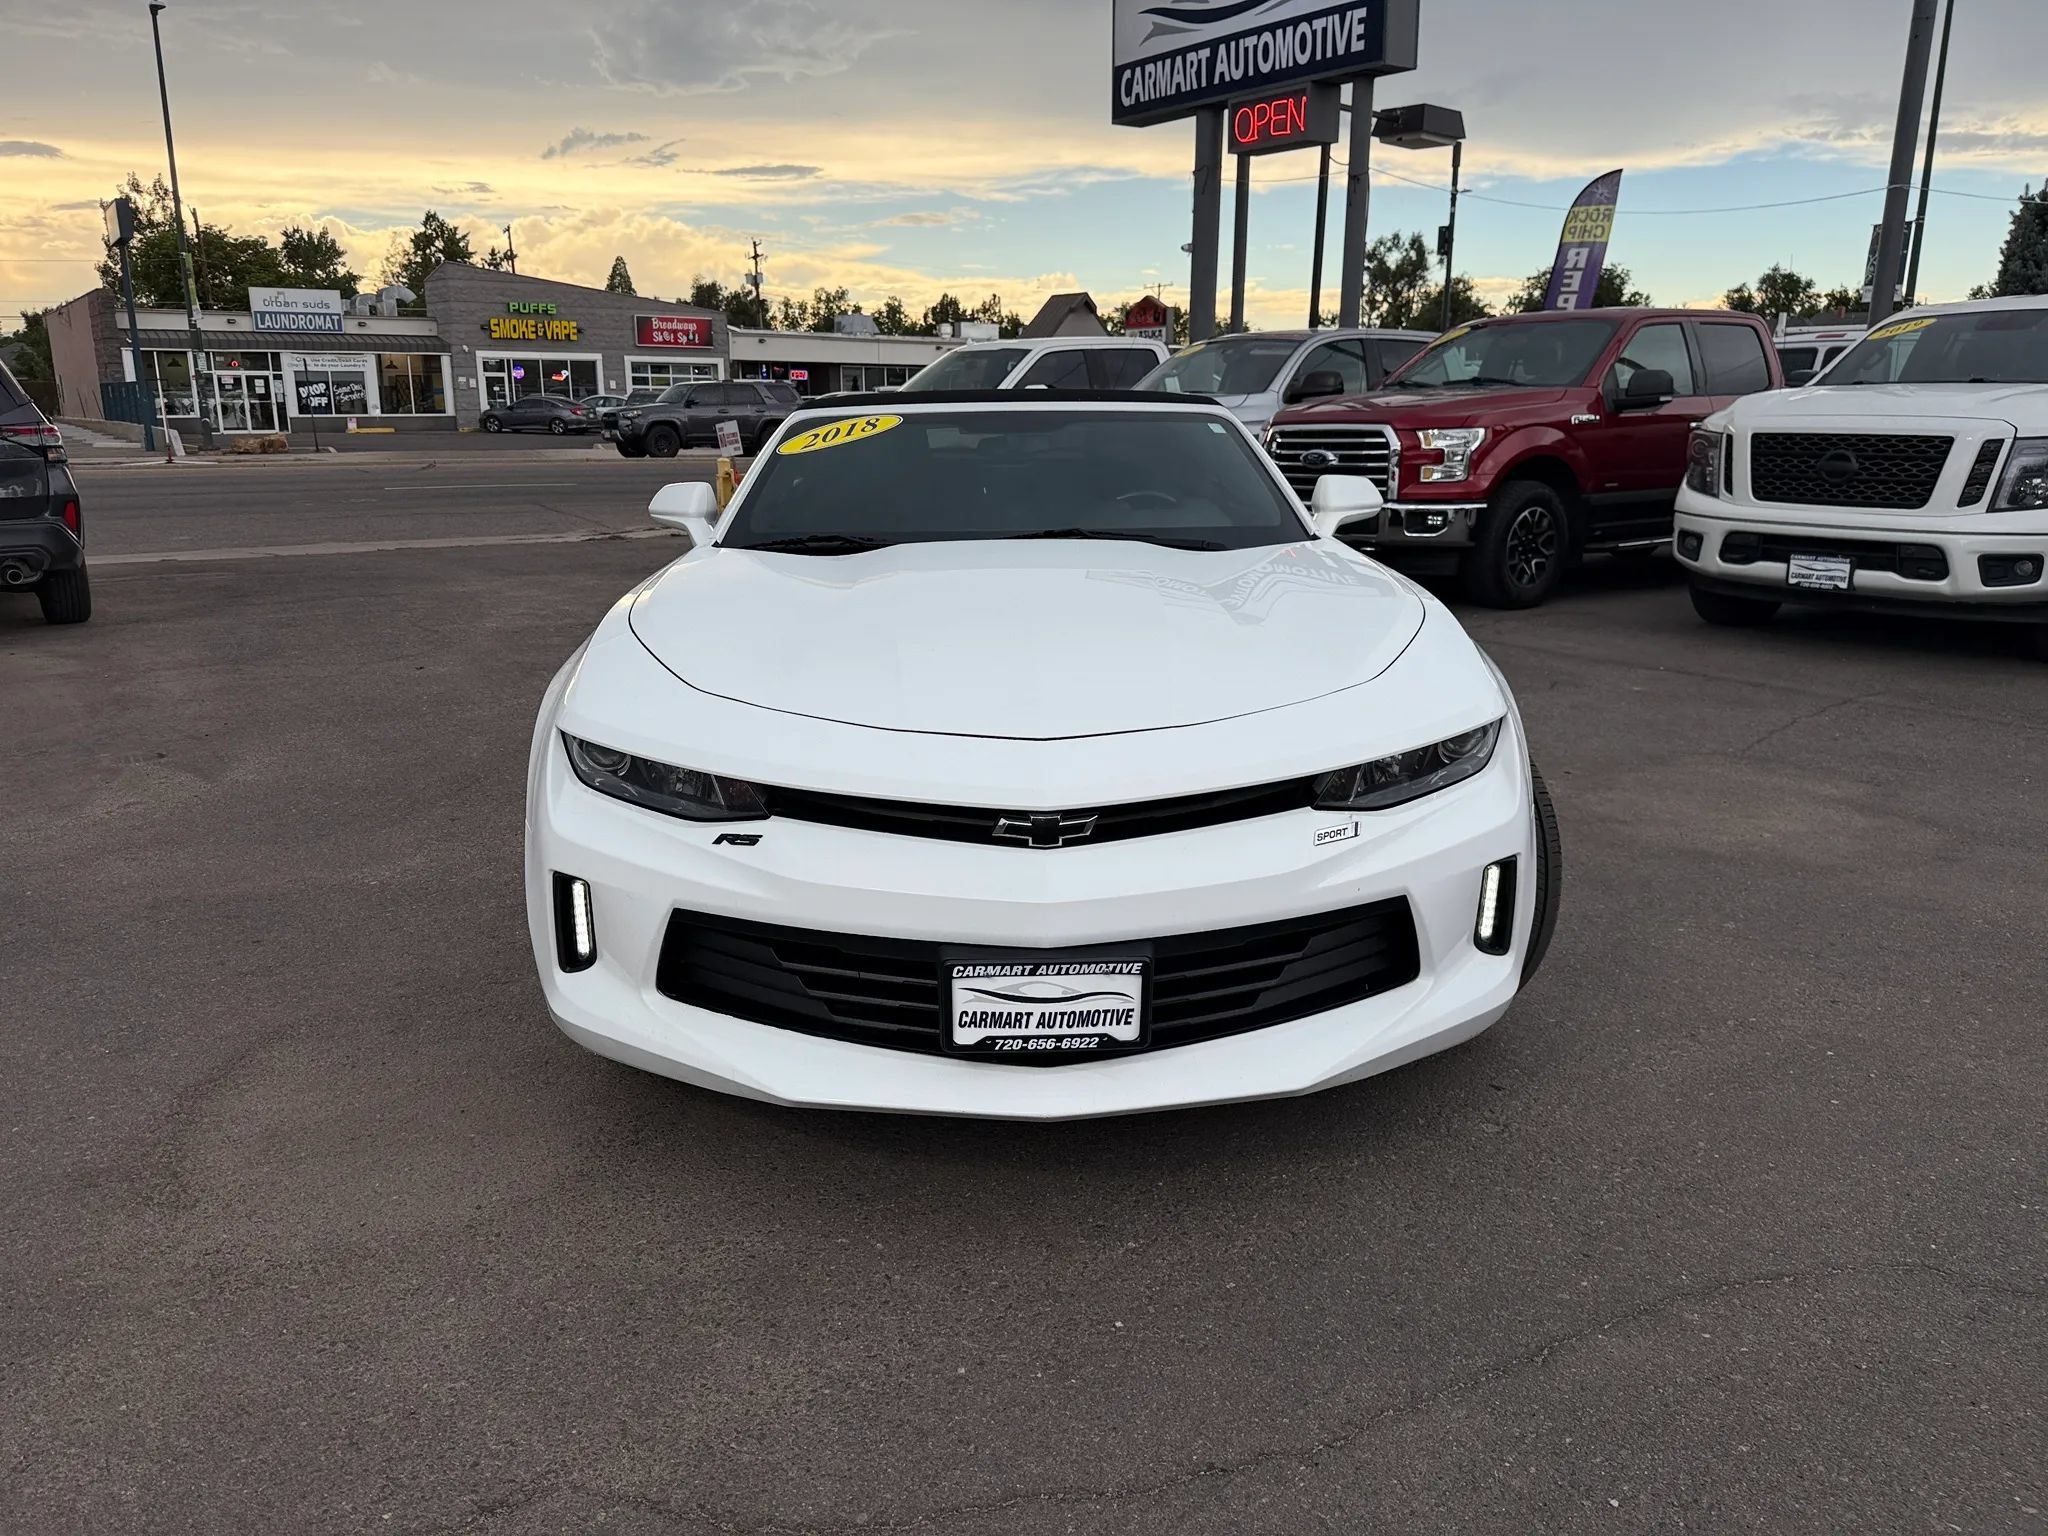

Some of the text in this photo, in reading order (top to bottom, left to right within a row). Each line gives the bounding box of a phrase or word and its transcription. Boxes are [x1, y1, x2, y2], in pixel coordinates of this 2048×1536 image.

[1120, 7, 1367, 107] CARMART AUTOMOTIVE
[1235, 96, 1307, 143] OPEN
[302, 300, 331, 309] suds
[509, 302, 557, 314] PUFFS
[256, 313, 340, 330] LAUNDROMAT
[490, 318, 578, 341] SMOKE & VAPE
[800, 418, 881, 450] 2018
[712, 833, 763, 846] RS
[1316, 827, 1348, 842] SPORT
[952, 962, 1143, 978] CARMART AUTOMOTIVE
[957, 1008, 1135, 1029] CARMART AUTOMOTIVE
[994, 1036, 1100, 1051] 720-656-6922
